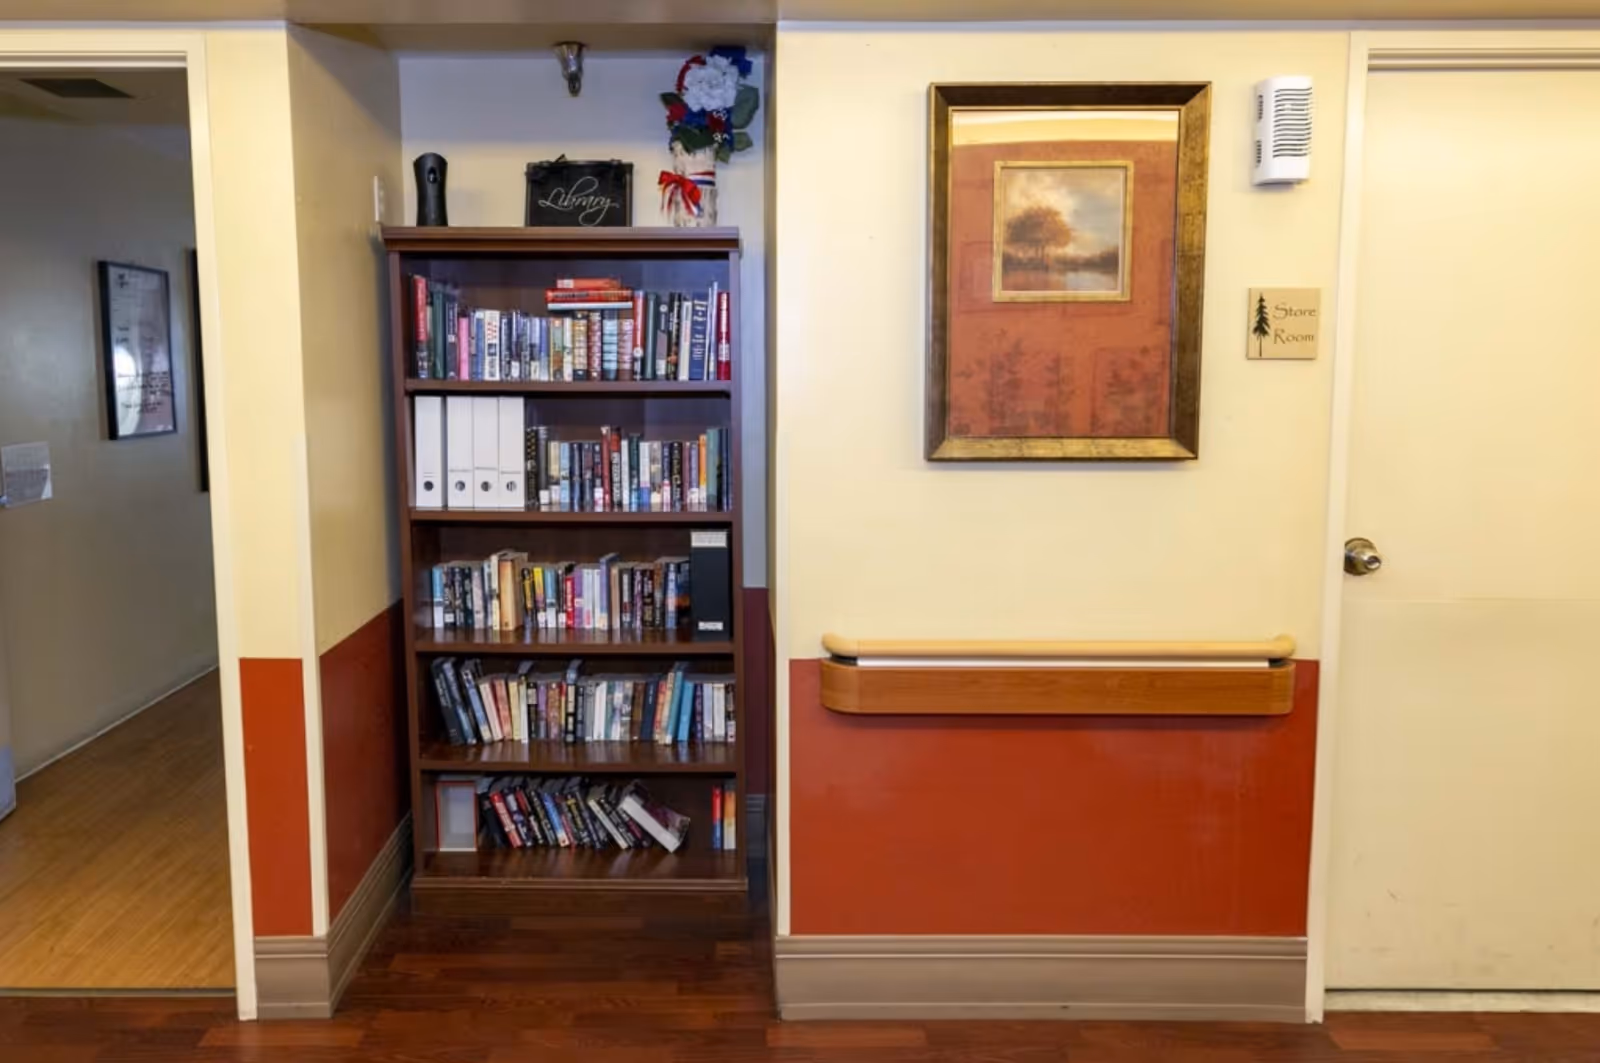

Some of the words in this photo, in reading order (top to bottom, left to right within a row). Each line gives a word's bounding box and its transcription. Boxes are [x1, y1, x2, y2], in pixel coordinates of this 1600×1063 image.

[538, 176, 619, 226] Library
[1272, 304, 1317, 320] Store
[1273, 328, 1315, 345] Room
